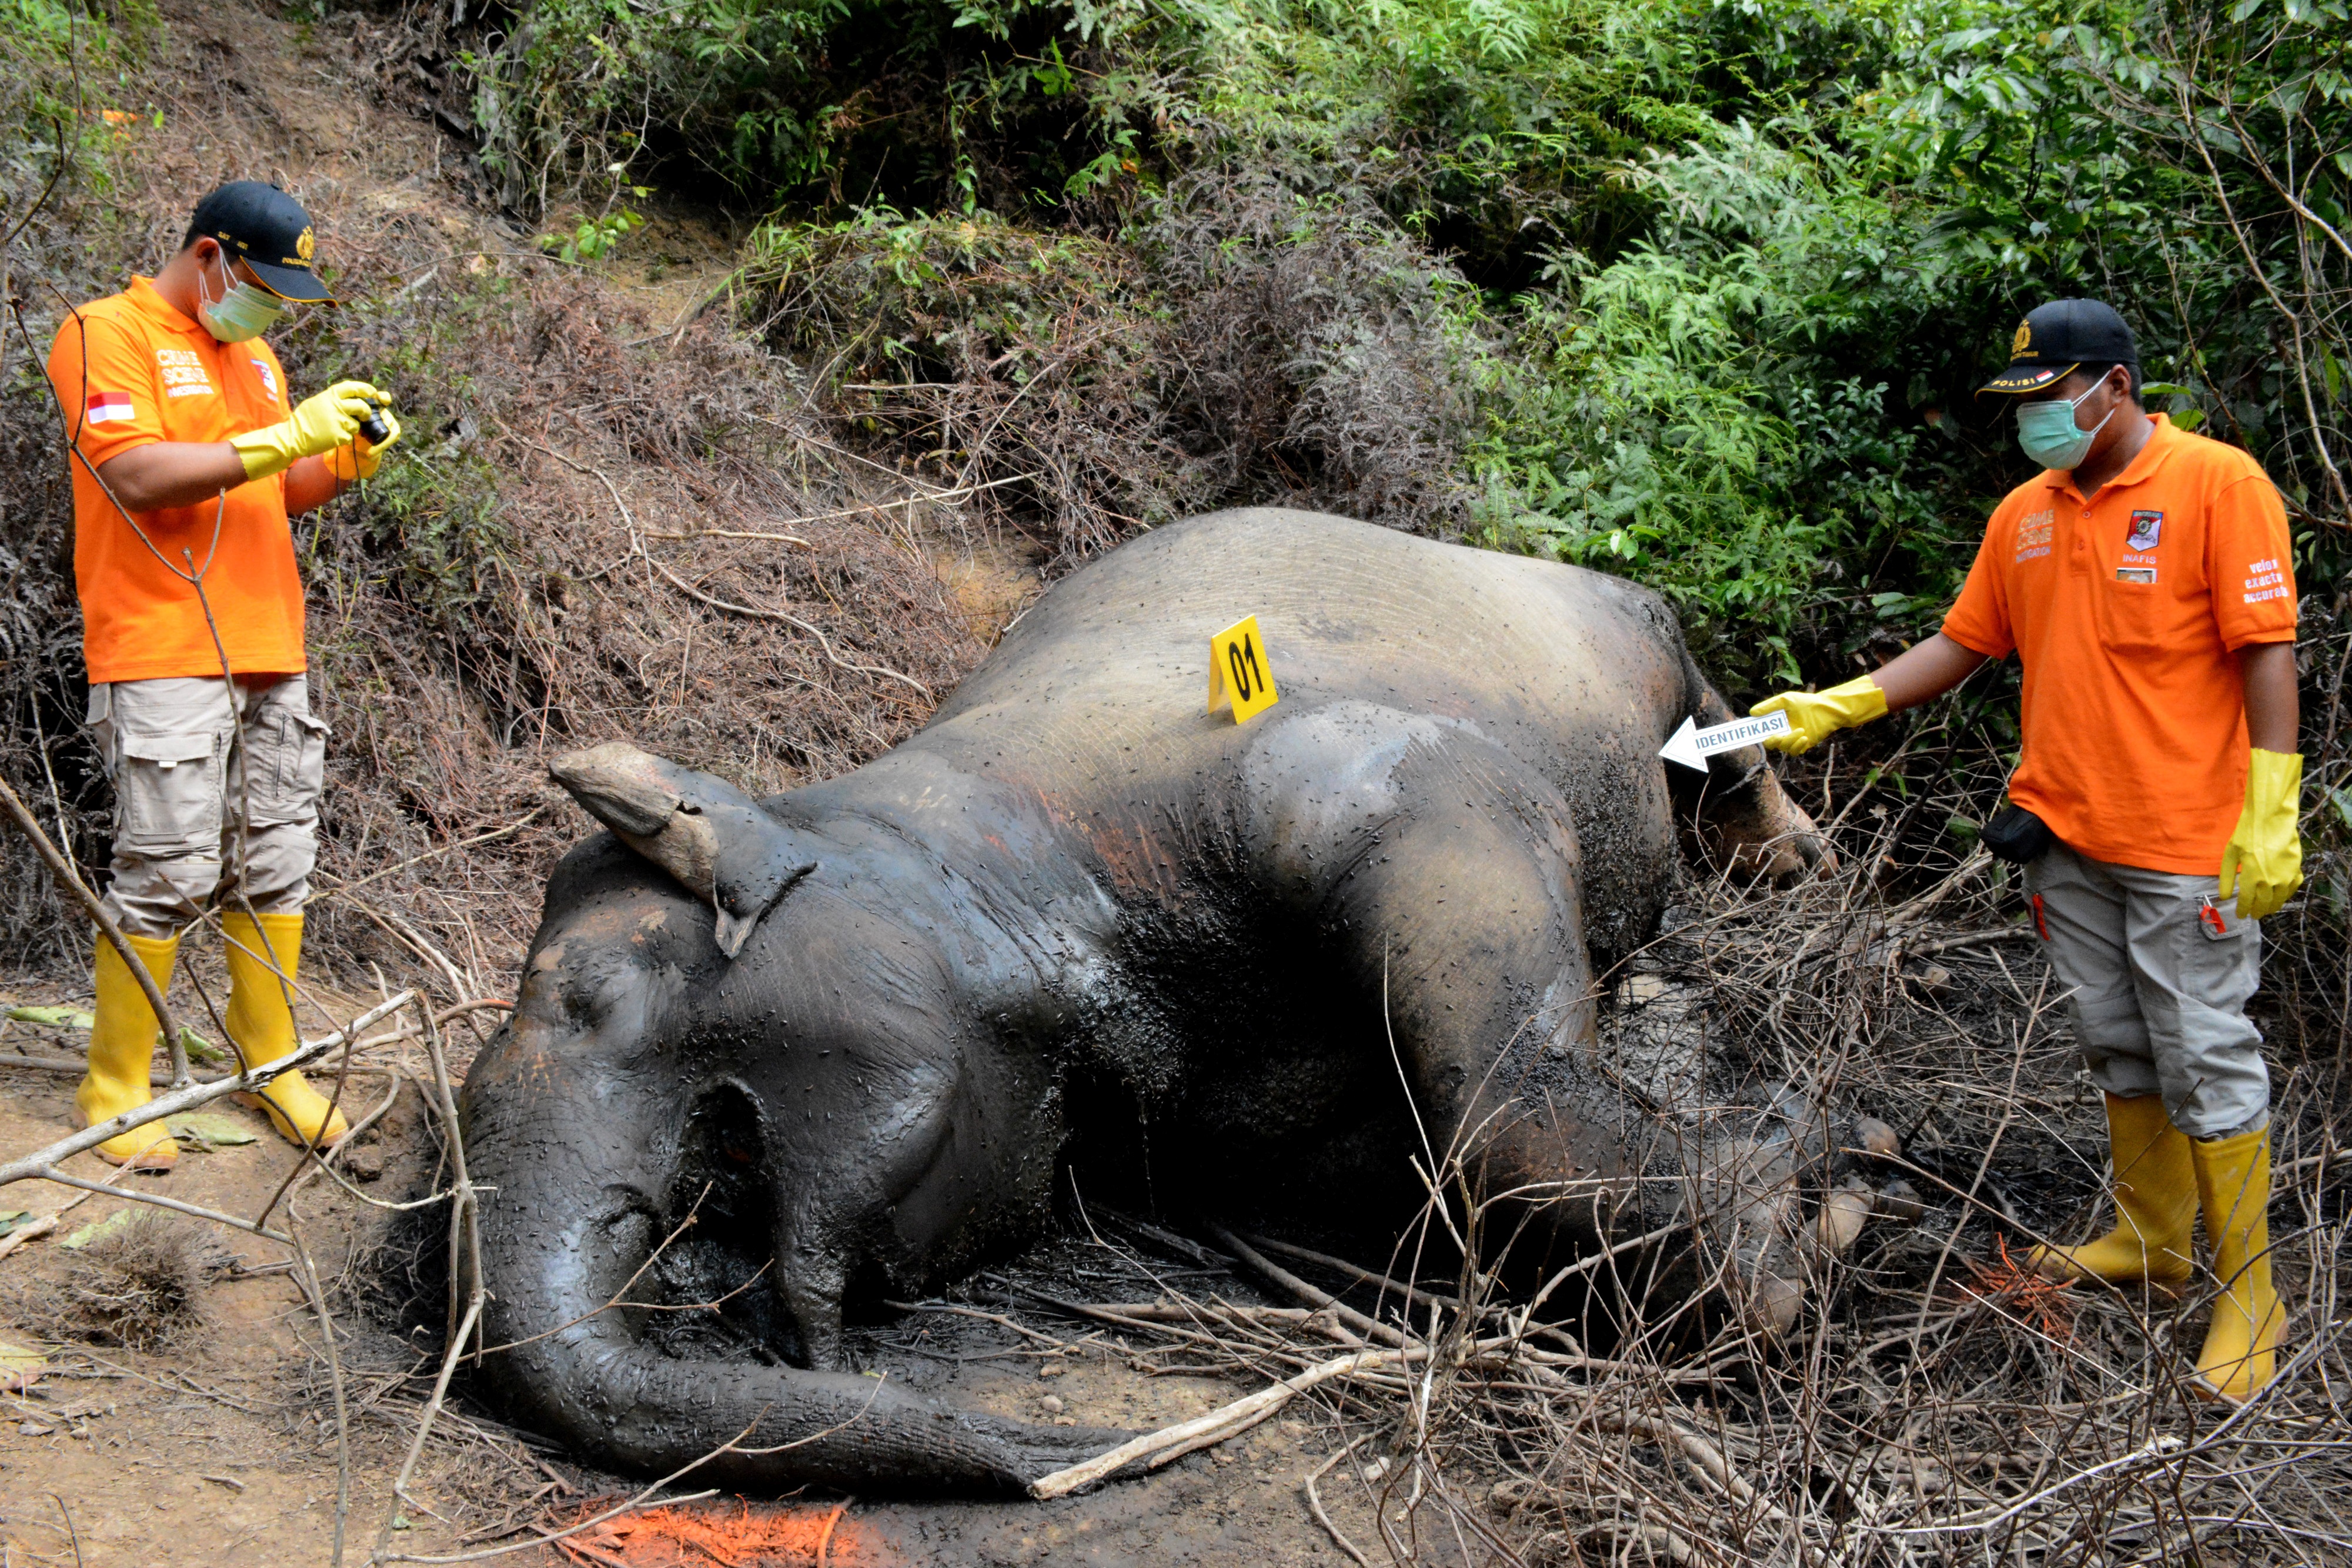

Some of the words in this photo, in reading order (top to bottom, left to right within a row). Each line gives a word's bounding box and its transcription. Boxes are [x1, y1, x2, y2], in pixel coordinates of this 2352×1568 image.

[156, 349, 201, 366] CRIME
[162, 366, 209, 385] SCENE
[1990, 377, 2036, 386] POLISI
[2122, 554, 2157, 564] INAFIS
[1228, 633, 1264, 702] 01
[1695, 717, 1784, 750] IDENTIFIKASI
